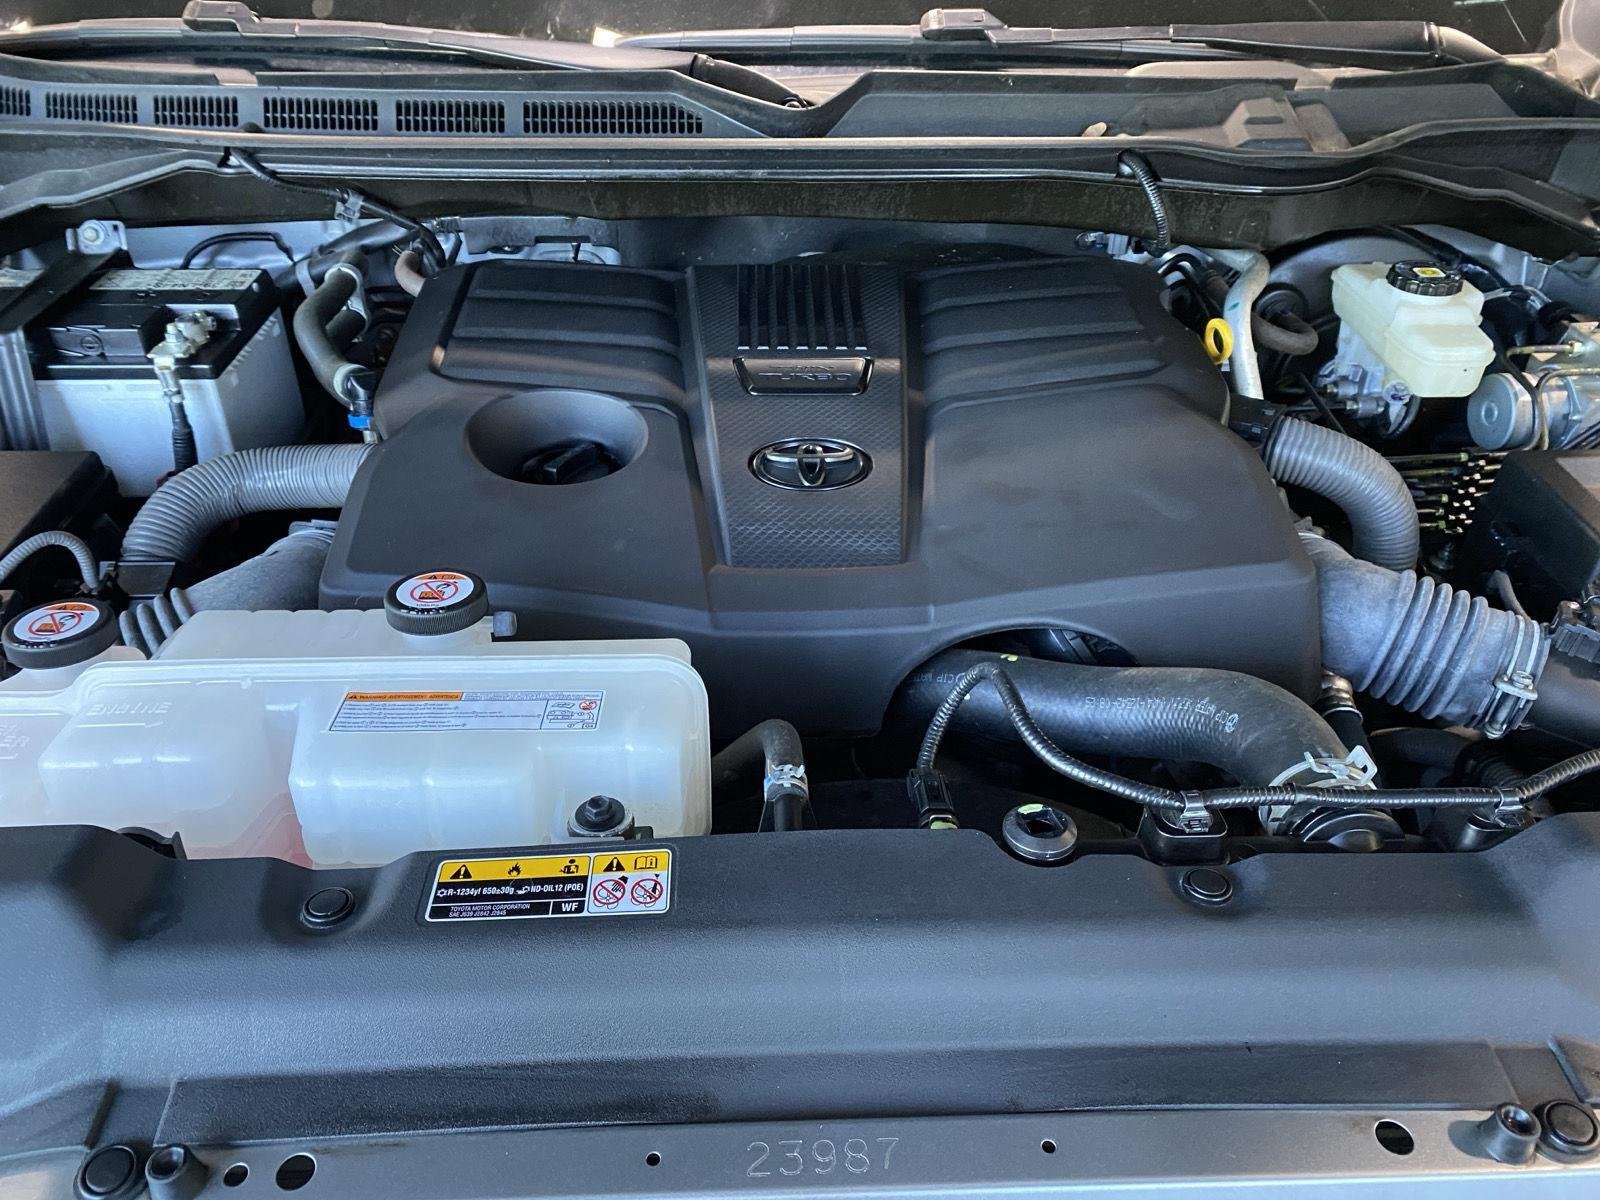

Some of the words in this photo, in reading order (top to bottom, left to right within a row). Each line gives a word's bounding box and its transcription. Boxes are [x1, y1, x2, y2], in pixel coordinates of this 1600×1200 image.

[757, 371, 853, 381] TURBO
[482, 886, 515, 896] 650±30g
[564, 883, 584, 893] (POE)
[492, 903, 531, 911] CORPORATION
[561, 902, 579, 912] WF
[746, 1136, 900, 1177] 23987
